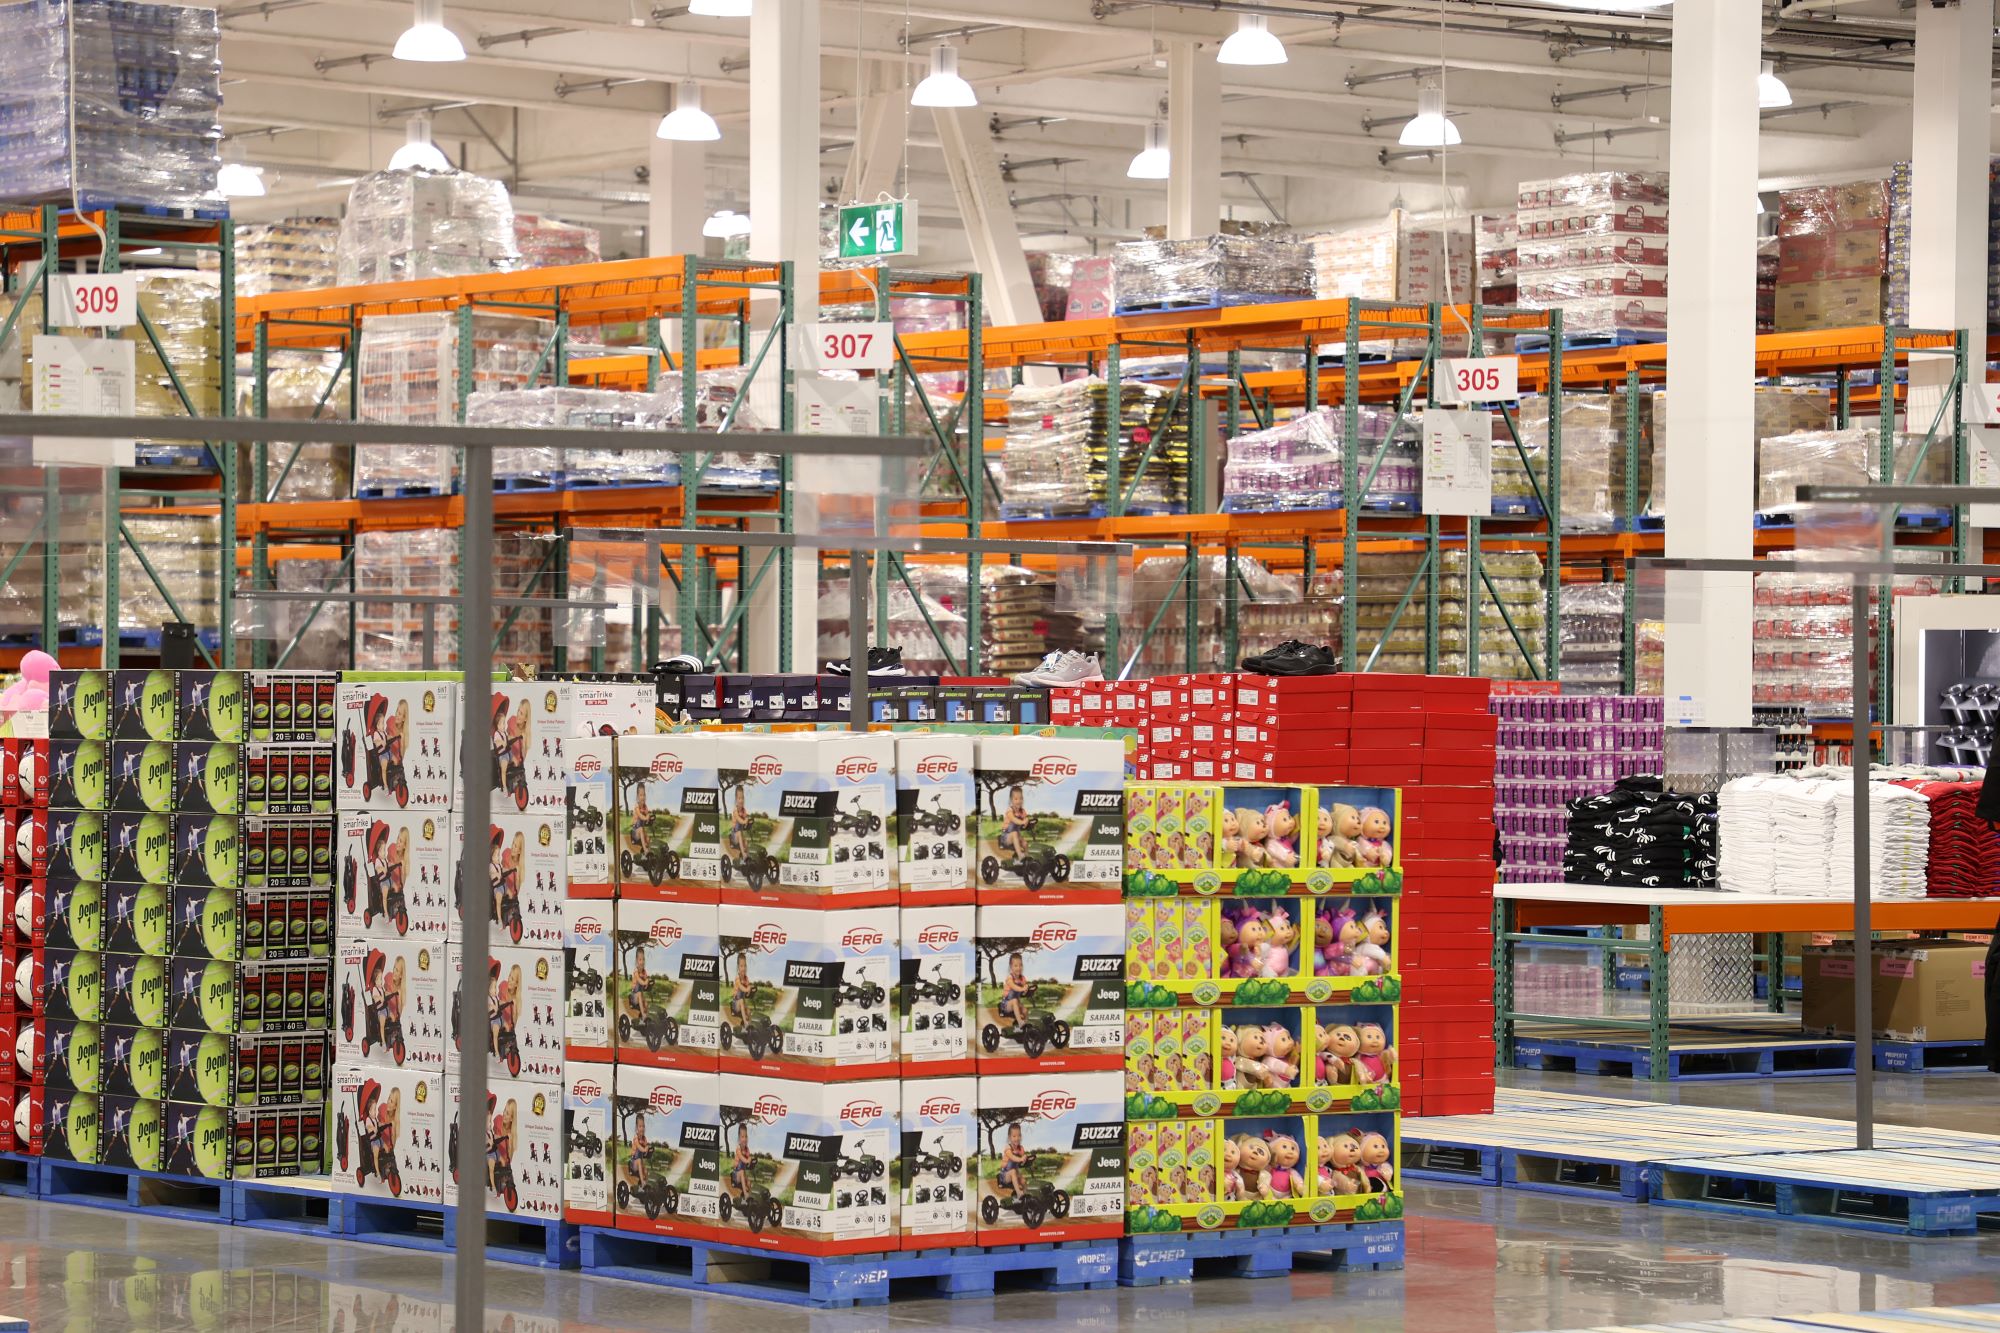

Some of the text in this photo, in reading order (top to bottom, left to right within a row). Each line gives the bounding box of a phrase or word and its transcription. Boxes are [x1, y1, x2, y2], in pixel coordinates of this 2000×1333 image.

[76, 287, 118, 313] 309
[824, 334, 873, 358] 307
[1457, 368, 1499, 391] 305
[83, 689, 104, 713] Penn
[343, 691, 368, 701] smarTrike
[579, 691, 612, 699] smarTrike
[150, 690, 172, 713] Penn
[218, 690, 240, 715] Penn
[93, 705, 96, 718] 1
[161, 706, 164, 718] 1
[229, 707, 232, 720] 1
[82, 759, 103, 782] Penn
[575, 761, 601, 771] BERG
[651, 761, 683, 773] BERG
[750, 762, 783, 776] BERG
[836, 763, 877, 775] BERG
[917, 762, 958, 773] BERG
[1032, 764, 1077, 775] BERG
[148, 761, 170, 784] Penn
[214, 762, 236, 786] Penn
[92, 775, 95, 787] 1
[158, 777, 162, 789] 1
[224, 779, 228, 791] 1
[686, 792, 715, 804] BUZZY
[784, 795, 817, 808] BUZZY
[1081, 795, 1121, 806] BUZZY
[344, 818, 368, 828] smarTrike
[699, 823, 715, 834] Jeep
[799, 827, 817, 839] Jeep
[1098, 824, 1119, 836] Jeep
[80, 830, 100, 854] Penn
[145, 833, 167, 856] Penn
[214, 835, 235, 859] Penn
[90, 847, 93, 859] 1
[155, 849, 158, 861] 1
[694, 847, 716, 855] SAHARA
[224, 852, 227, 864] 1
[78, 901, 98, 923] Penn
[143, 903, 163, 926] Penn
[87, 917, 91, 928] 1
[211, 908, 233, 931] Penn
[153, 920, 156, 932] 1
[222, 925, 226, 937] 1
[575, 924, 601, 933] BERG
[651, 926, 682, 939] BERG
[753, 931, 787, 945] BERG
[919, 932, 959, 943] BERG
[1032, 929, 1077, 941] BERG
[842, 933, 882, 946] BERG
[685, 959, 715, 971] BUZZY
[1081, 959, 1121, 971] BUZZY
[789, 965, 822, 978] BUZZY
[77, 972, 98, 994] Penn
[140, 976, 162, 999] Penn
[87, 987, 90, 999] 1
[151, 992, 154, 1004] 1
[209, 981, 231, 1003] Penn
[698, 990, 714, 1002] Jeep
[1098, 989, 1119, 1000] Jeep
[220, 997, 223, 1009] 1
[803, 997, 821, 1010] Jeep
[693, 1014, 715, 1022] SAHARA
[799, 1023, 822, 1031] SAHARA
[77, 1043, 97, 1064] Penn
[1520, 1048, 1540, 1056] CHEP
[87, 1059, 90, 1070] 1
[138, 1048, 159, 1071] Penn
[205, 1053, 227, 1076] Penn
[149, 1064, 152, 1076] 1
[215, 1070, 219, 1082] 1
[573, 1086, 601, 1096] BERG
[651, 1093, 682, 1106] BERG
[1030, 1098, 1076, 1111] BERG
[754, 1101, 787, 1117] BERG
[840, 1107, 882, 1119] BERG
[920, 1104, 961, 1115] BERG
[75, 1113, 95, 1135] Penn
[85, 1129, 88, 1141] 1
[137, 1119, 158, 1142] Penn
[685, 1127, 716, 1141] BUZZY
[1080, 1126, 1121, 1140] BUZZY
[147, 1136, 150, 1148] 1
[202, 1126, 224, 1150] Penn
[213, 1143, 217, 1156] 1
[790, 1137, 821, 1152] BUZZY
[699, 1159, 715, 1172] Jeep
[1098, 1157, 1120, 1168] Jeep
[803, 1170, 820, 1184] Jeep
[694, 1183, 716, 1192] SAHARA
[798, 1196, 821, 1205] SAHARA
[1936, 1204, 1971, 1222] CHEP
[1149, 1249, 1185, 1263] CHEP
